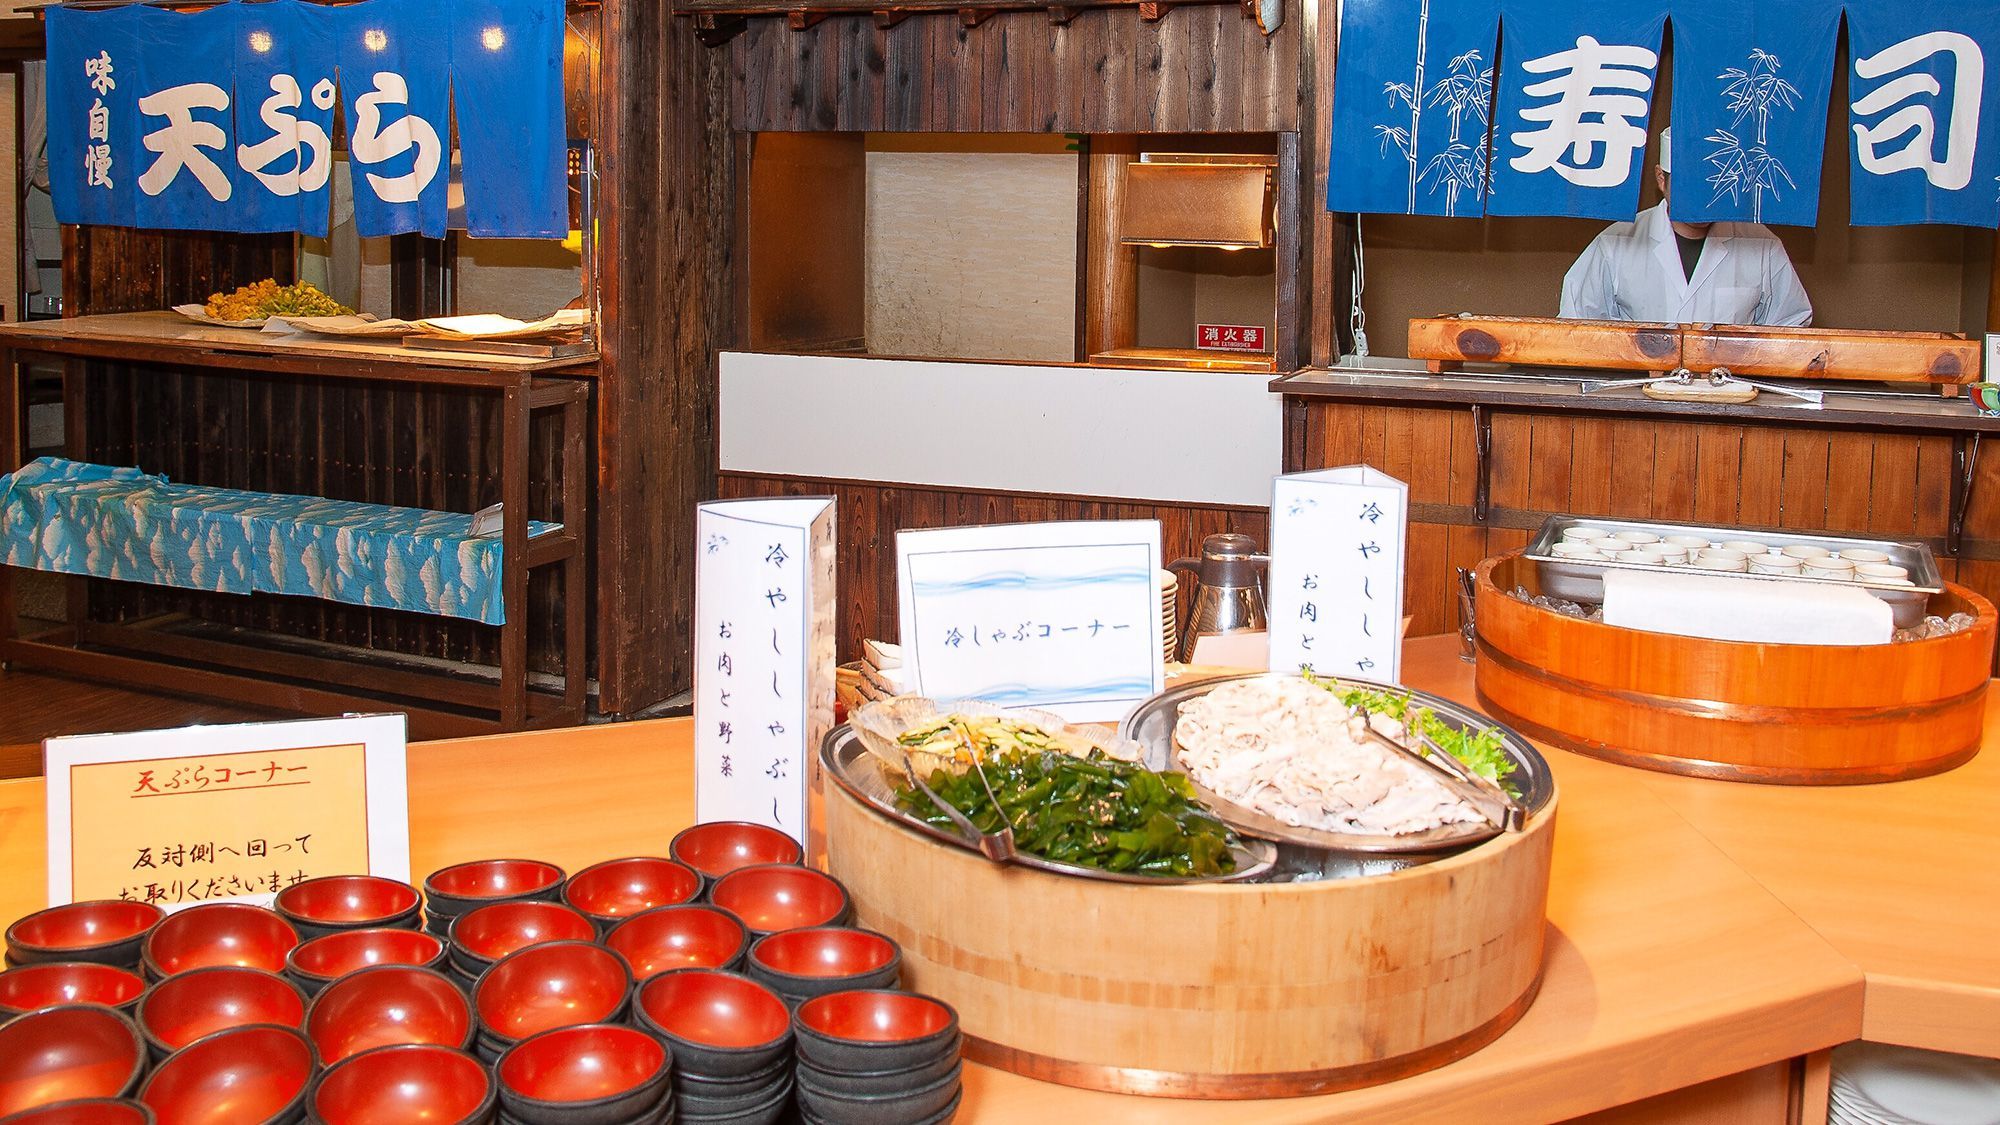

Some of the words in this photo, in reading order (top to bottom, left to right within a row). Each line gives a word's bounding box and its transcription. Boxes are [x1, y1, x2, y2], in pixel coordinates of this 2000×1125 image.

[84, 49, 117, 190] 味自慢
[138, 71, 442, 202] 天ぷら
[1509, 31, 1985, 191] 寿司
[1204, 327, 1258, 342] 消火器
[944, 618, 1131, 648] 冷しゃぶコーナー
[717, 619, 734, 778] お肉と野菜
[133, 760, 308, 793] 天ぷらコーナー
[132, 834, 312, 870] 反対側へ回って
